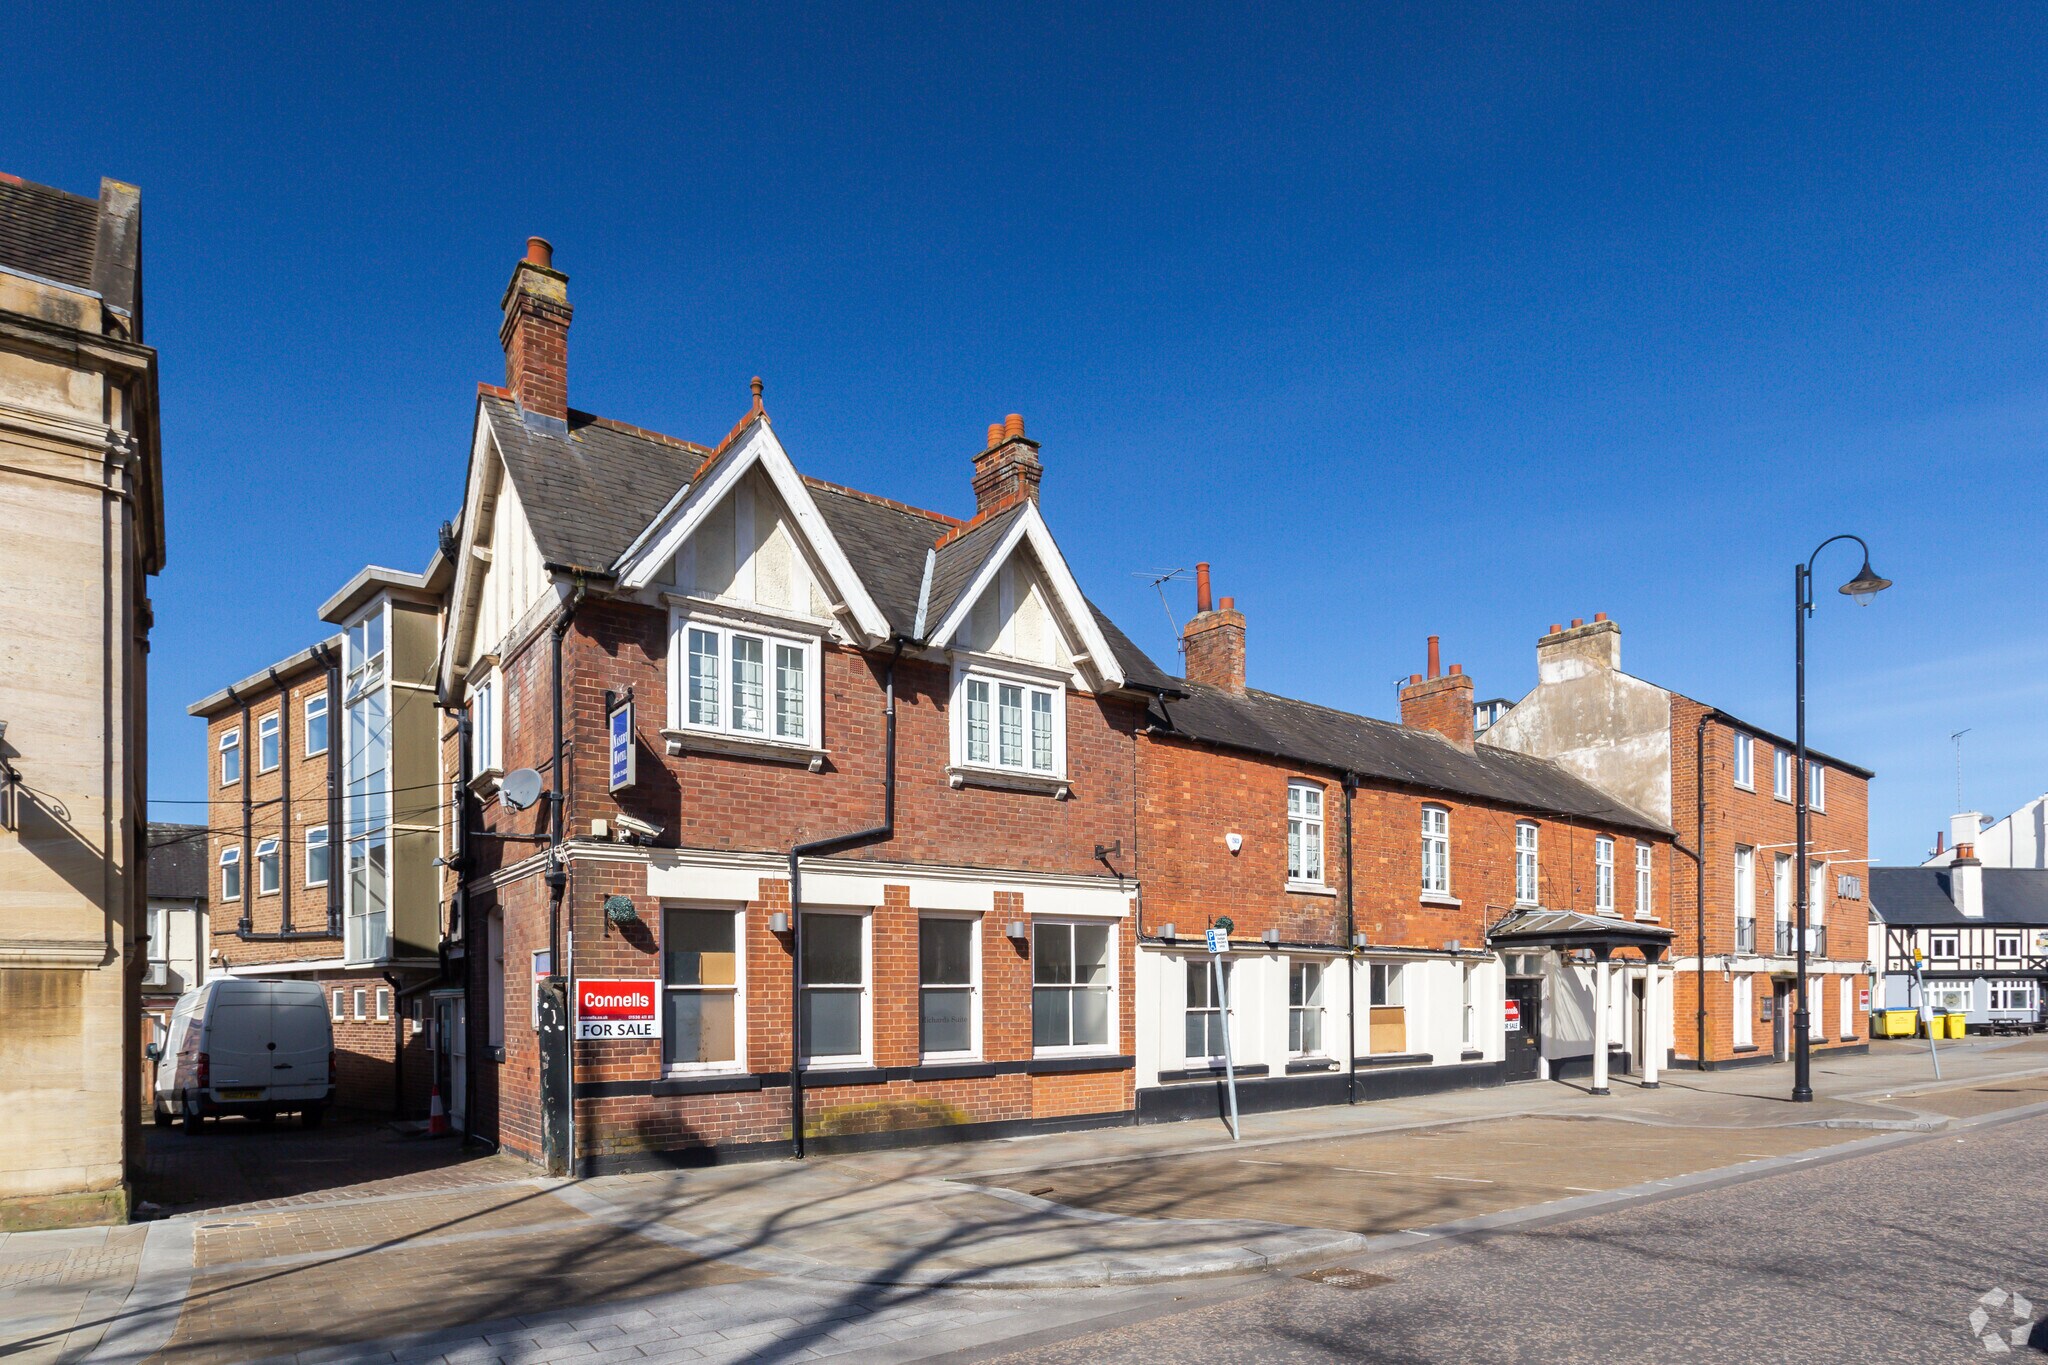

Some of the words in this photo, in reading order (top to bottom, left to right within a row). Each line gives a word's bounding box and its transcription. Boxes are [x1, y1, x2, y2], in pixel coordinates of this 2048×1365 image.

[1208, 932, 1214, 940] P
[584, 992, 649, 1007] Connells
[582, 1023, 613, 1037] FOR
[617, 1023, 652, 1036] SALE
